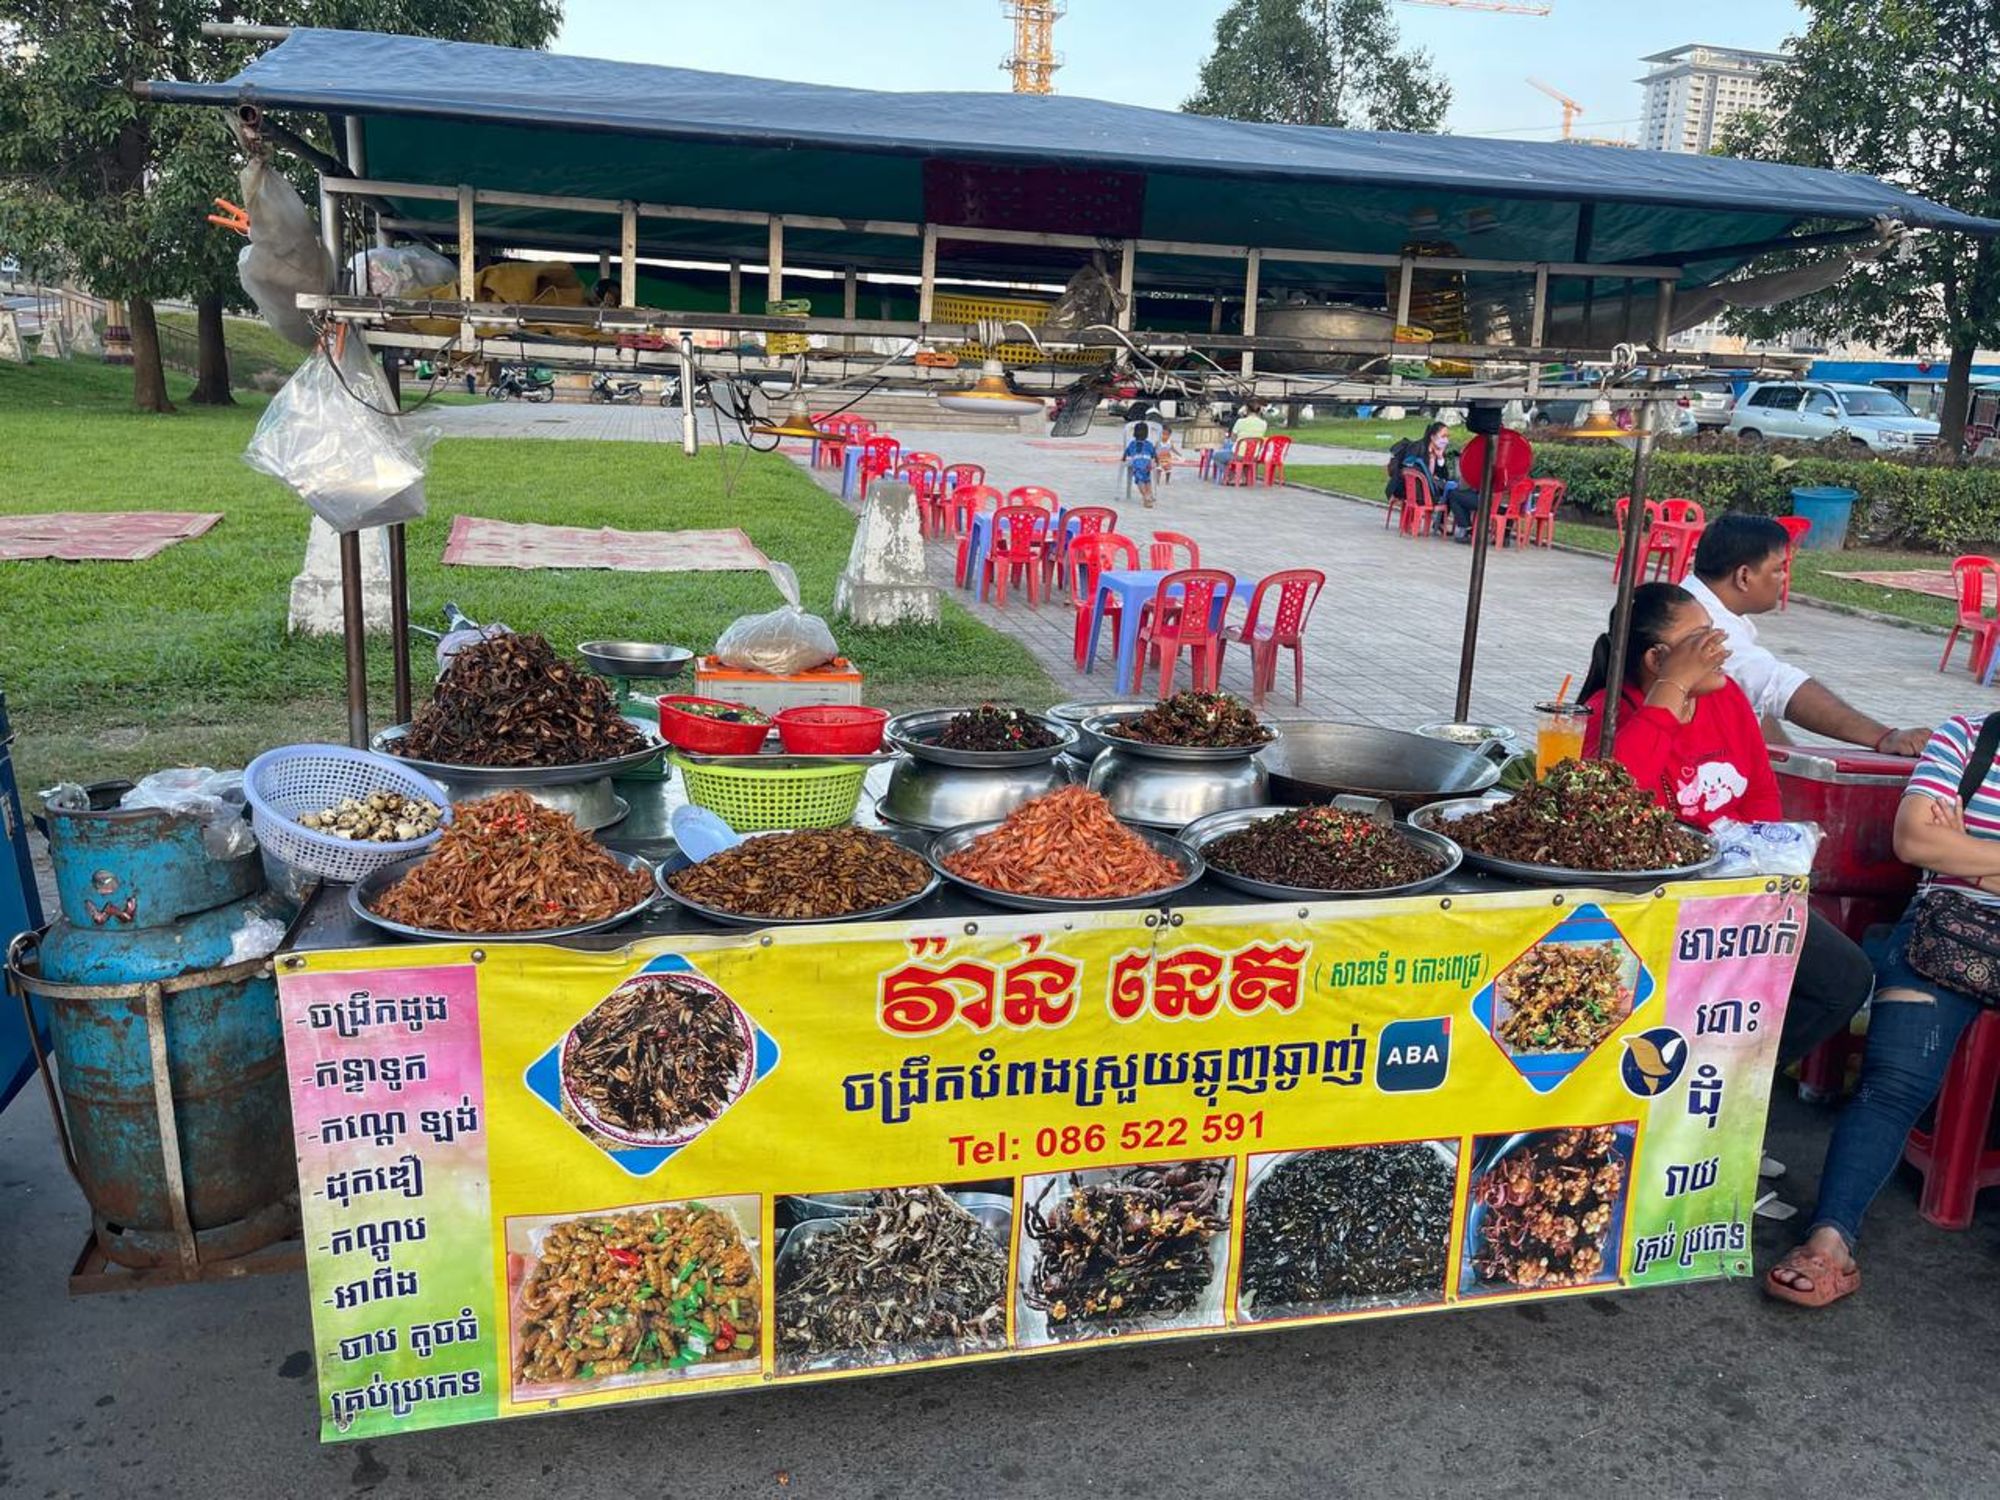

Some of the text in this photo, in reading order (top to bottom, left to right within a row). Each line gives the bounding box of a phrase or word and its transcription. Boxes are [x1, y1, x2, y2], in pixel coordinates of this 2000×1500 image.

[1679, 907, 1799, 961] មានលក់
[1386, 1045, 1439, 1066] ABA
[949, 1110, 1265, 1166] Tel: 086 522 591
[1665, 1156, 1719, 1197] រាយ
[1633, 1222, 1745, 1273] គ្រប់ ប្រភេទ
[411, 1308, 478, 1357] តូចធំ
